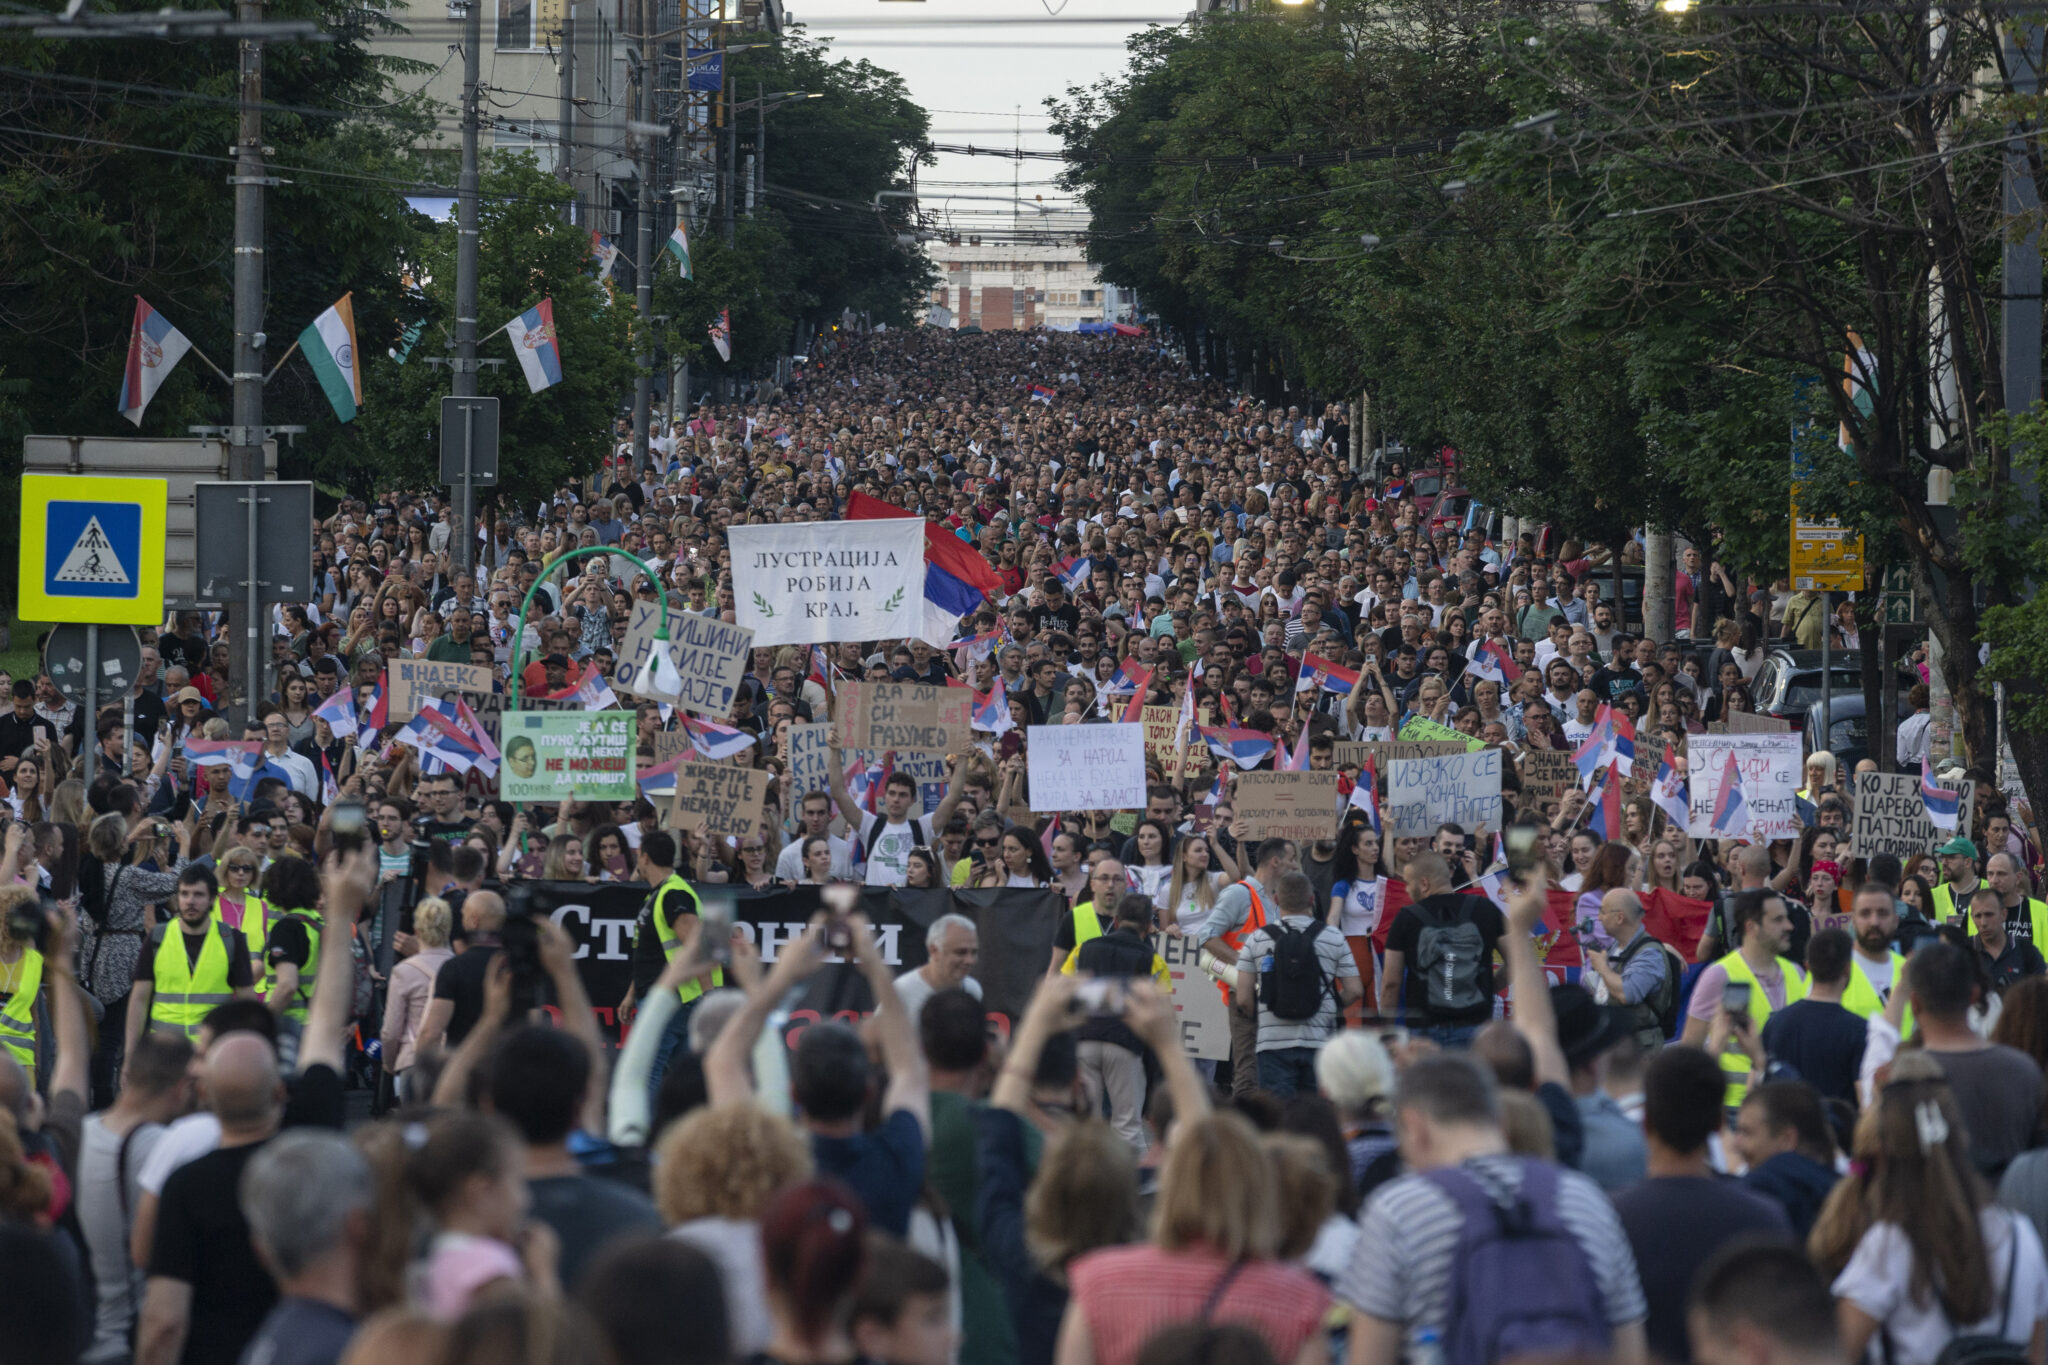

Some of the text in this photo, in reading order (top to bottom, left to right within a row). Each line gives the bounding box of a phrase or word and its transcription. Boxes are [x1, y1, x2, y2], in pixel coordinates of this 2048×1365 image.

[753, 551, 898, 569] ЛУСТРАЦИЈА
[787, 576, 871, 592] РОБИЈА
[805, 601, 860, 618] КРАЈ.
[633, 607, 752, 660] У ТИШИНИ
[872, 684, 937, 703] ДА ЛИ
[870, 705, 895, 722] СИ
[1144, 707, 1172, 723] ЗАКОН
[1410, 717, 1425, 728] НЕ
[576, 721, 592, 733] ЈЕ
[611, 721, 628, 733] СЕ
[869, 724, 947, 748] РАЗУМЕО
[1403, 728, 1421, 741] МИ
[541, 734, 628, 746] ПУНО ЉУТИШ
[1039, 729, 1061, 745] АКО
[1065, 728, 1092, 746] НЕМА
[564, 747, 628, 758] КАД НЕКОГ
[1057, 748, 1128, 766] ЗА НАРОД
[545, 758, 626, 771] НЕ МОЖЕШ
[1396, 757, 1464, 787] ИЗВУКО
[1473, 753, 1497, 776] СЕ
[555, 773, 626, 785] ДА КУПИШ?
[685, 765, 749, 784] ЖИВОТИ
[1037, 770, 1066, 789] НЕКА
[1090, 768, 1124, 786] БУДЕ
[1537, 768, 1549, 781] СЕ
[1776, 771, 1790, 783] СЕ
[692, 780, 752, 801] ДЕЦЕ
[1426, 782, 1468, 804] КОНАЦ
[1861, 774, 1881, 795] КО
[1884, 777, 1904, 795] ЈЕ
[680, 796, 737, 817] НЕМАЈУ
[1078, 790, 1094, 807] ЗА
[1102, 788, 1140, 806] ВЛАСТ
[1863, 796, 1923, 817] ЦАРЕВО
[706, 815, 752, 835] ЦЕНУ
[1392, 802, 1428, 830] ПАРА
[1859, 817, 1938, 843] ПАТУЉЦИ
